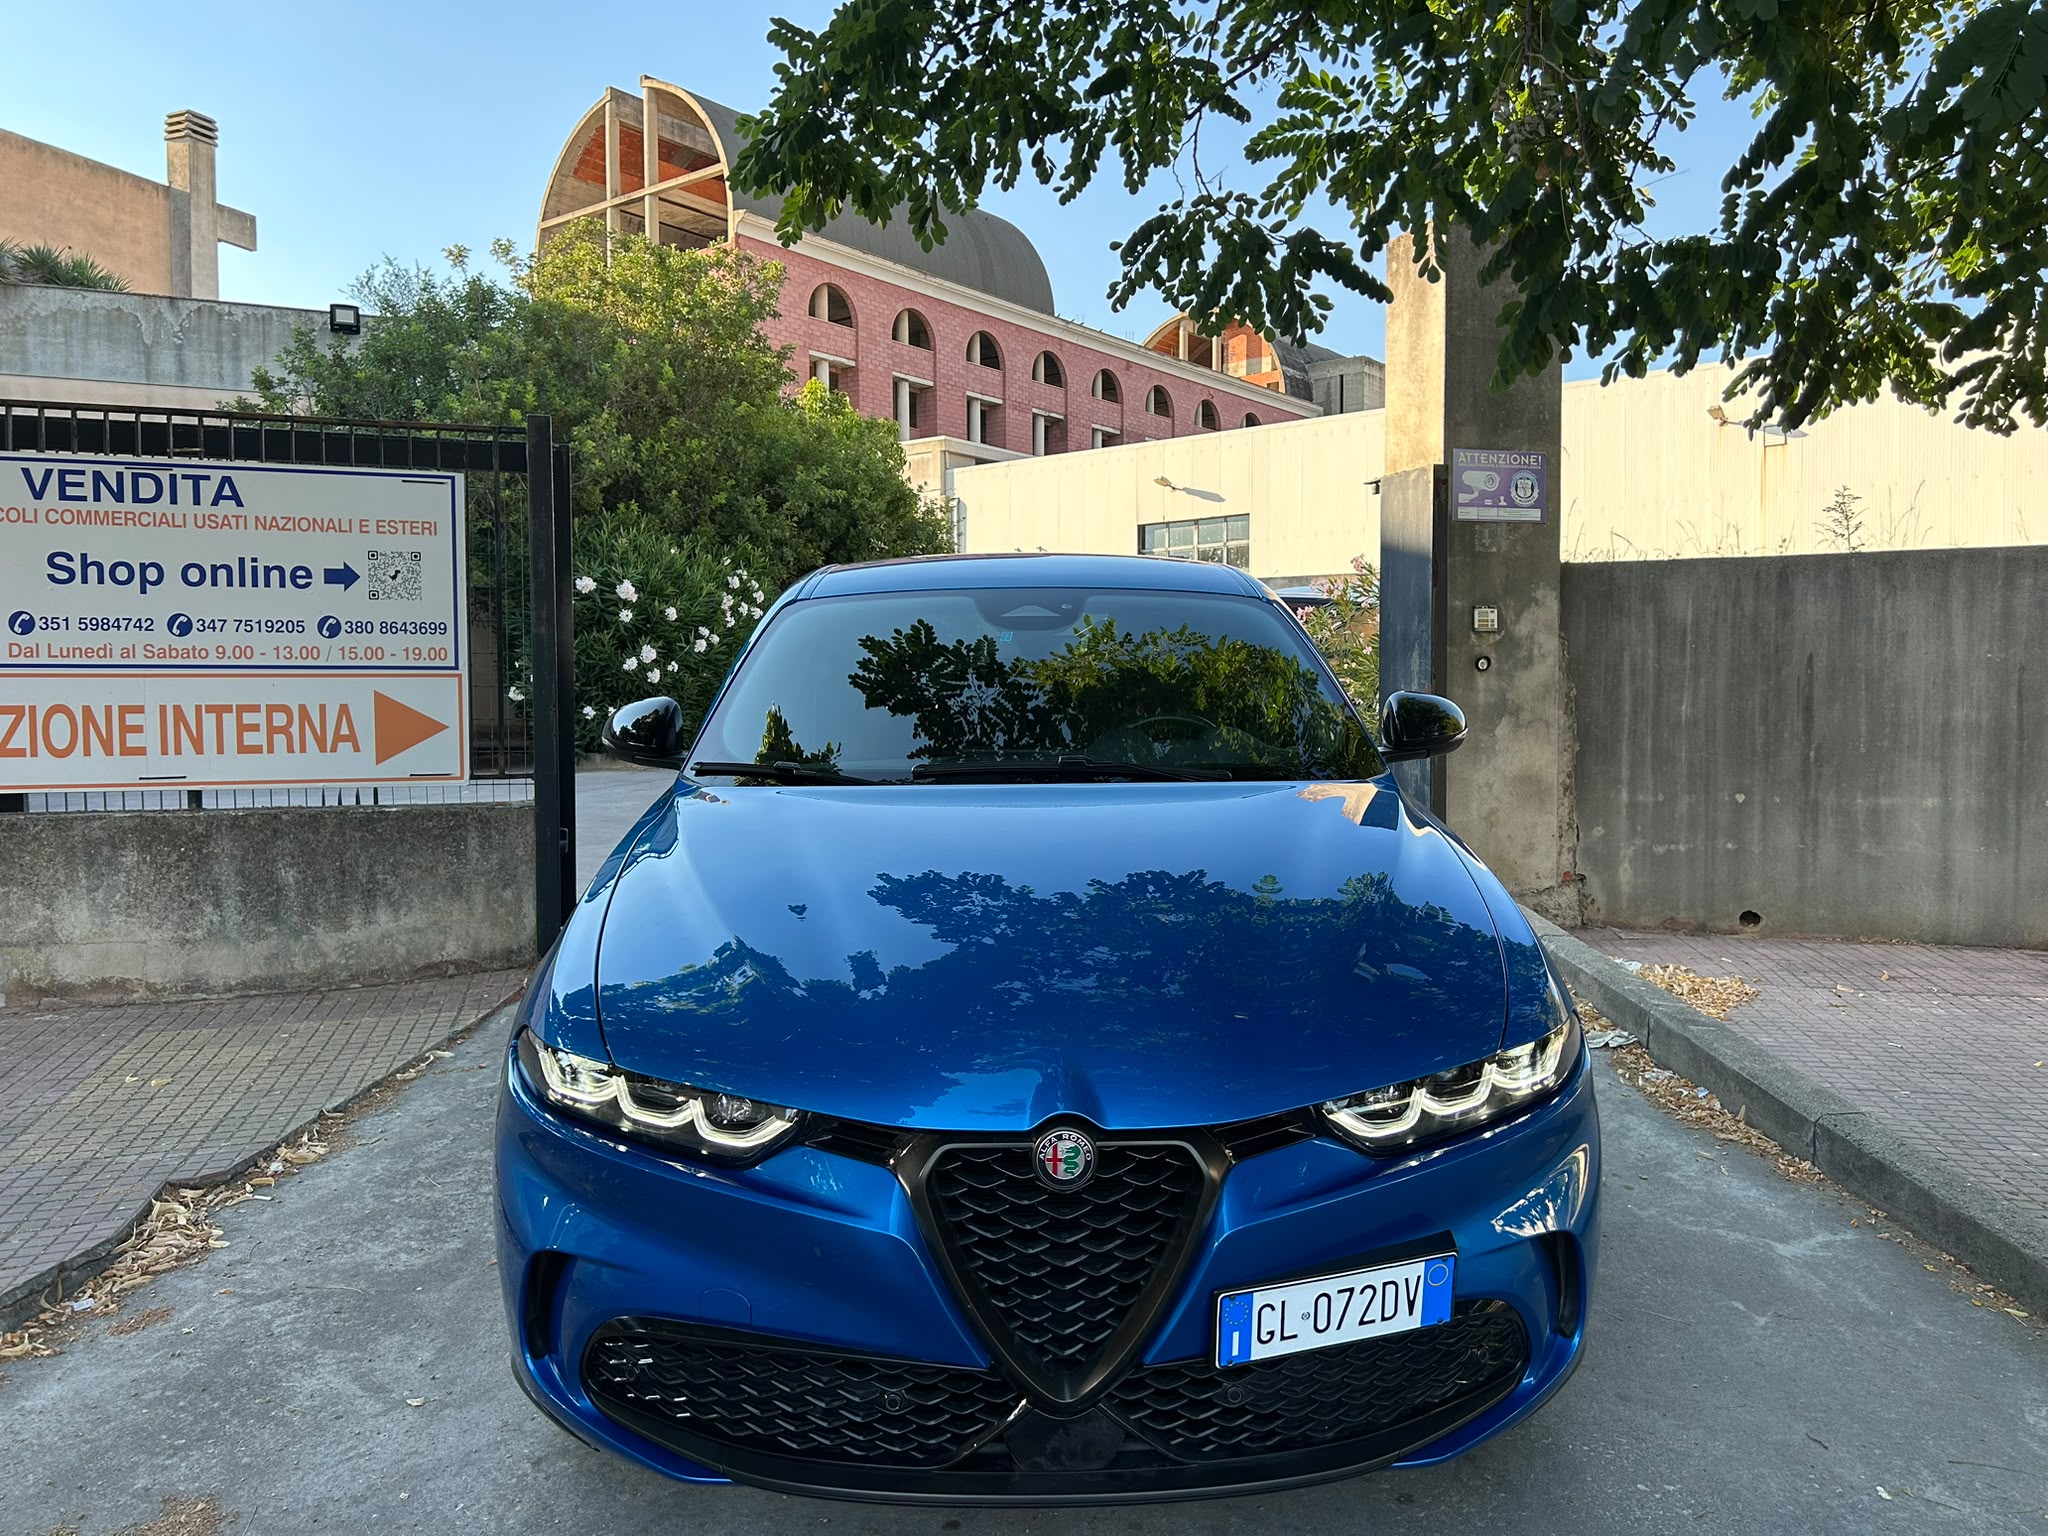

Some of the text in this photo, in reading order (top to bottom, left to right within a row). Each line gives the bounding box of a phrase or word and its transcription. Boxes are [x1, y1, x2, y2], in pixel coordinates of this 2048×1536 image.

[1459, 452, 1541, 468] ATTENZIONE!
[21, 467, 244, 508] VENDITA
[45, 508, 187, 528] COMMERCIALI
[194, 513, 248, 530] USATI
[255, 516, 352, 534] NAZIONALI
[359, 519, 369, 534] E
[376, 520, 438, 536] ESTERI
[46, 551, 313, 594] Shop online
[38, 617, 154, 632] 351 5984742
[196, 618, 305, 634] 347 7519205
[344, 620, 447, 636] 380 8643699
[8, 643, 40, 659] Dal
[47, 643, 113, 660] Lunedì
[120, 644, 136, 660] al
[143, 644, 209, 660] Sabato
[215, 645, 254, 660] 9.00
[273, 645, 320, 660] 13.00
[338, 646, 385, 661] 15.00
[403, 647, 447, 661] 19.00
[0, 703, 361, 759] ZIONE INTERNA
[1039, 1134, 1091, 1160] ALFA ROMEO
[1256, 1275, 1421, 1345] GL 072DV
